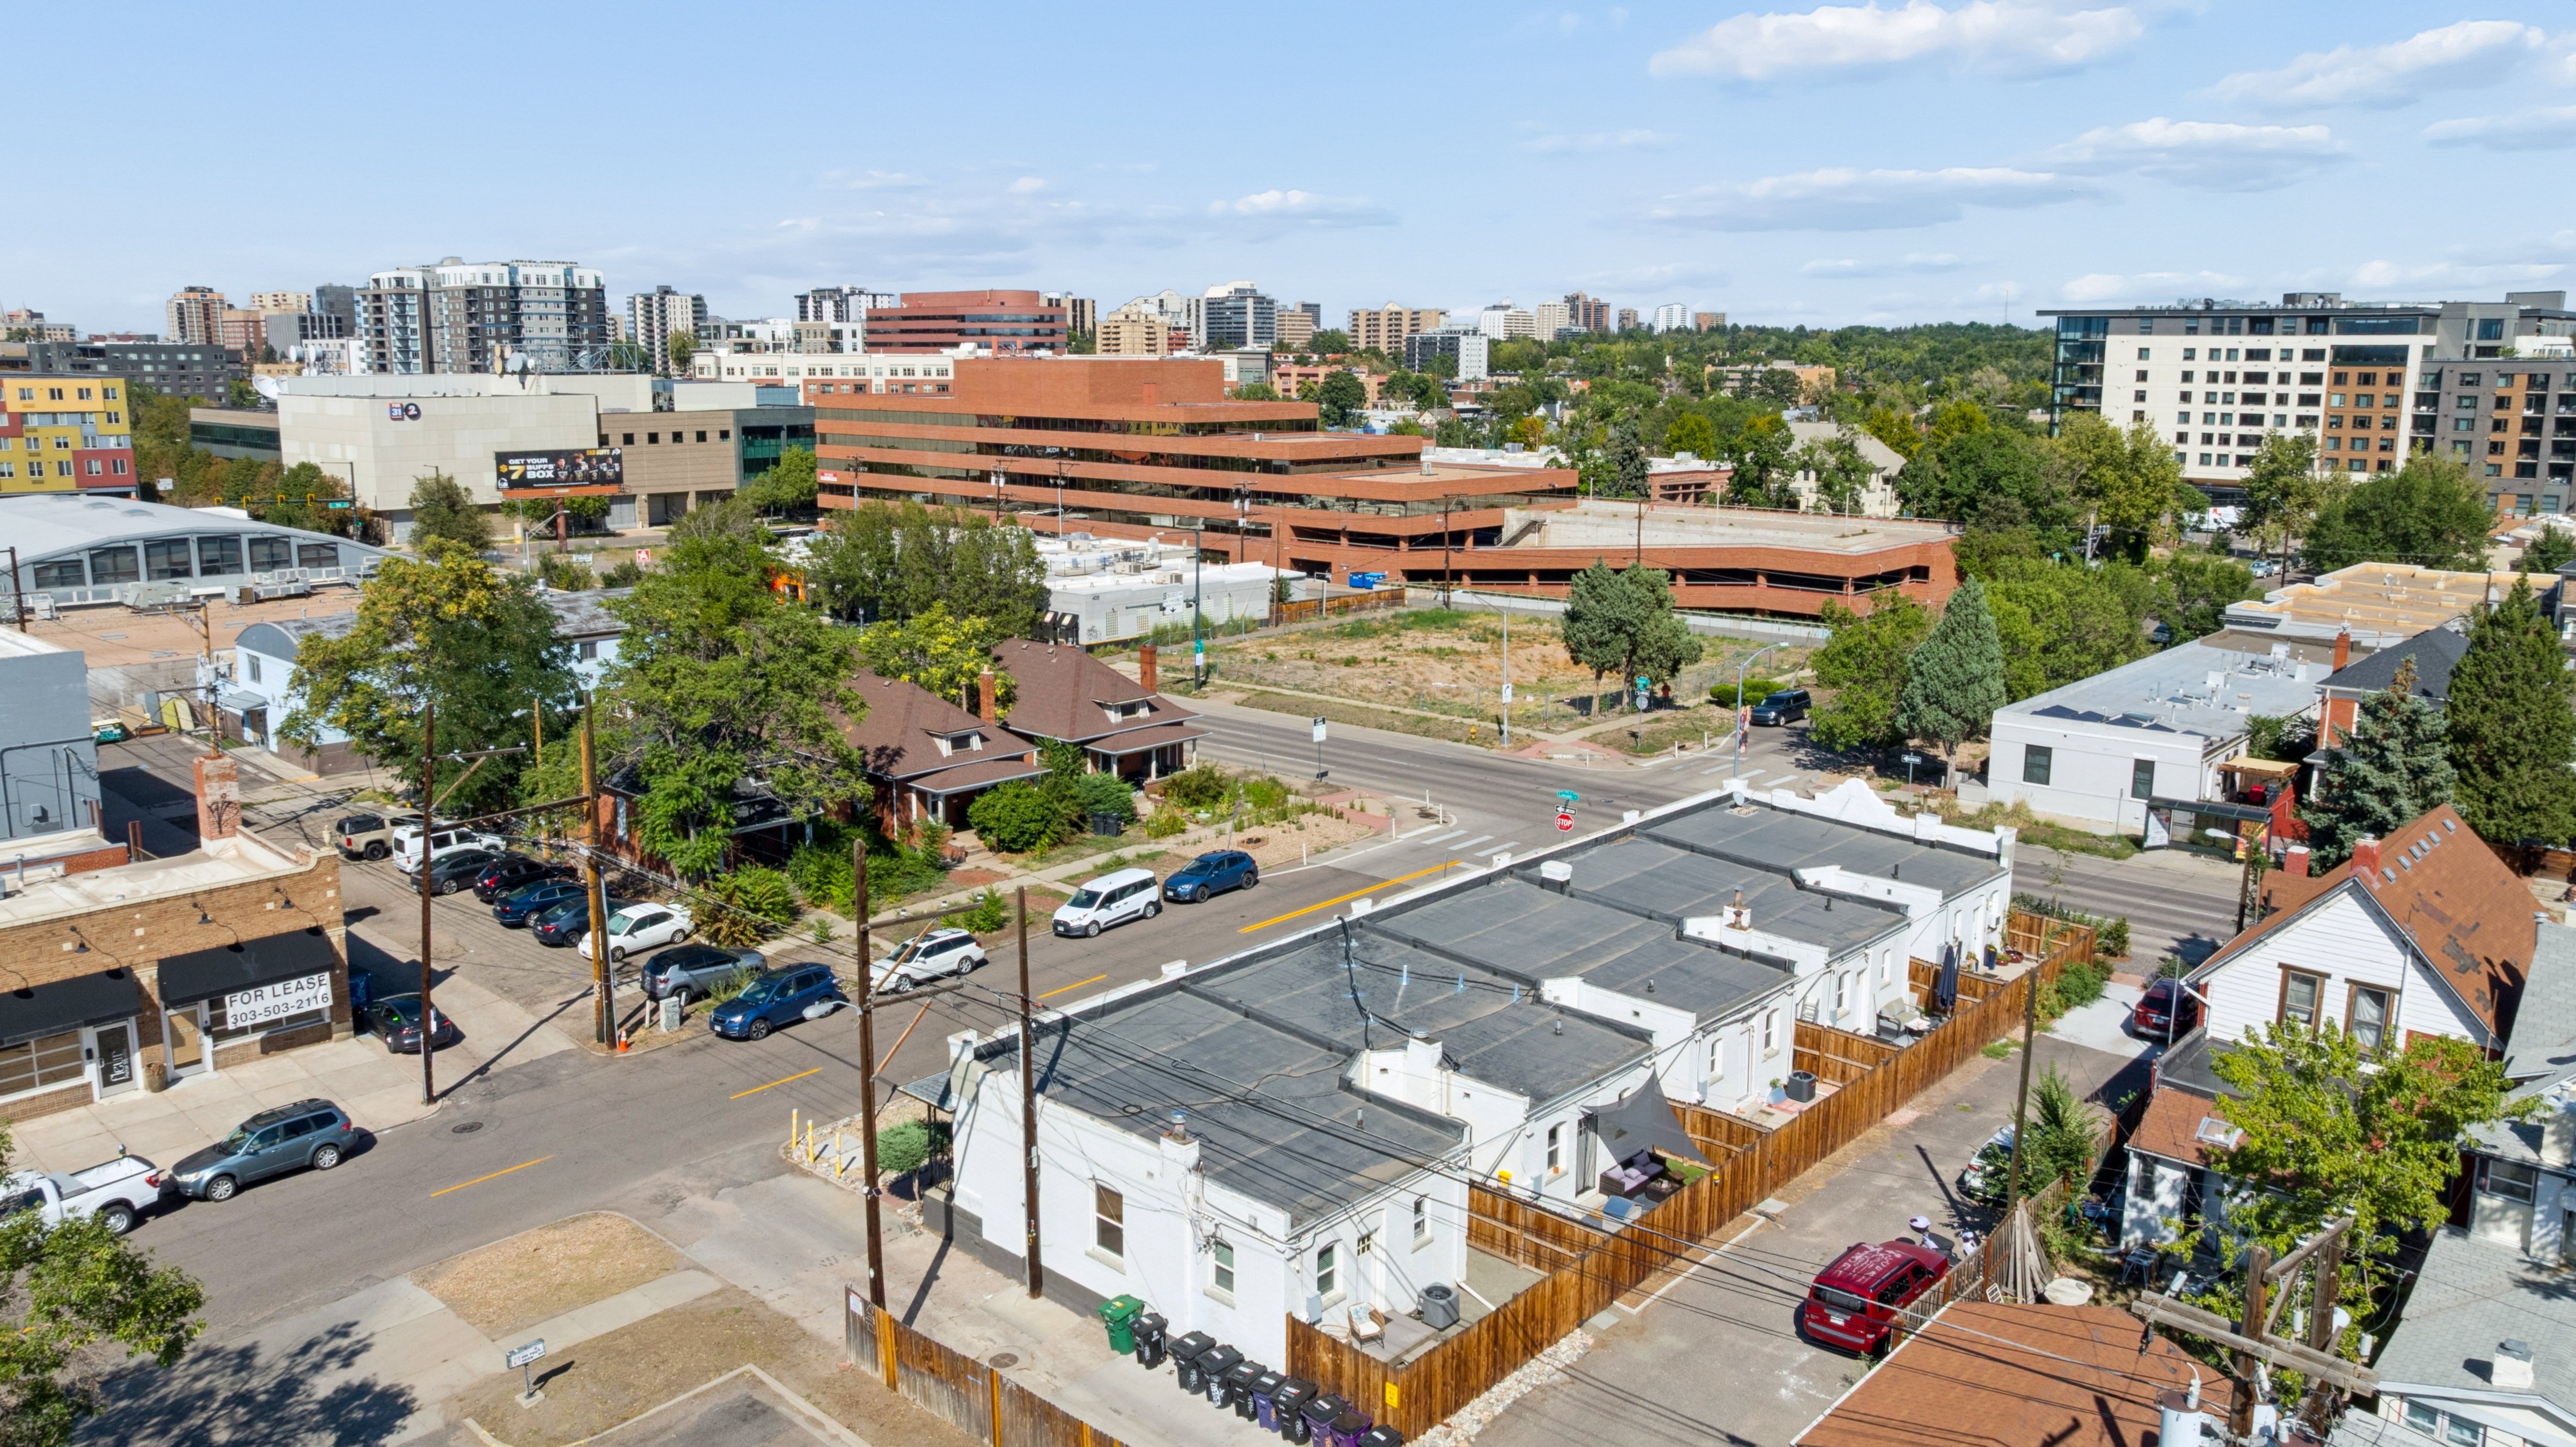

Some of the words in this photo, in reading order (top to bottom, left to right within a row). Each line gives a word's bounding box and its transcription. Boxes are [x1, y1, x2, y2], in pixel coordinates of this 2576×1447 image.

[392, 408, 402, 416] 31
[408, 405, 418, 415] 2
[526, 470, 554, 479] BOX
[1556, 818, 1572, 827] STOP
[229, 989, 264, 1007] FOR
[272, 975, 327, 998] LEASE
[231, 993, 329, 1025] 303-503-2116
[109, 1050, 125, 1082] fleur
